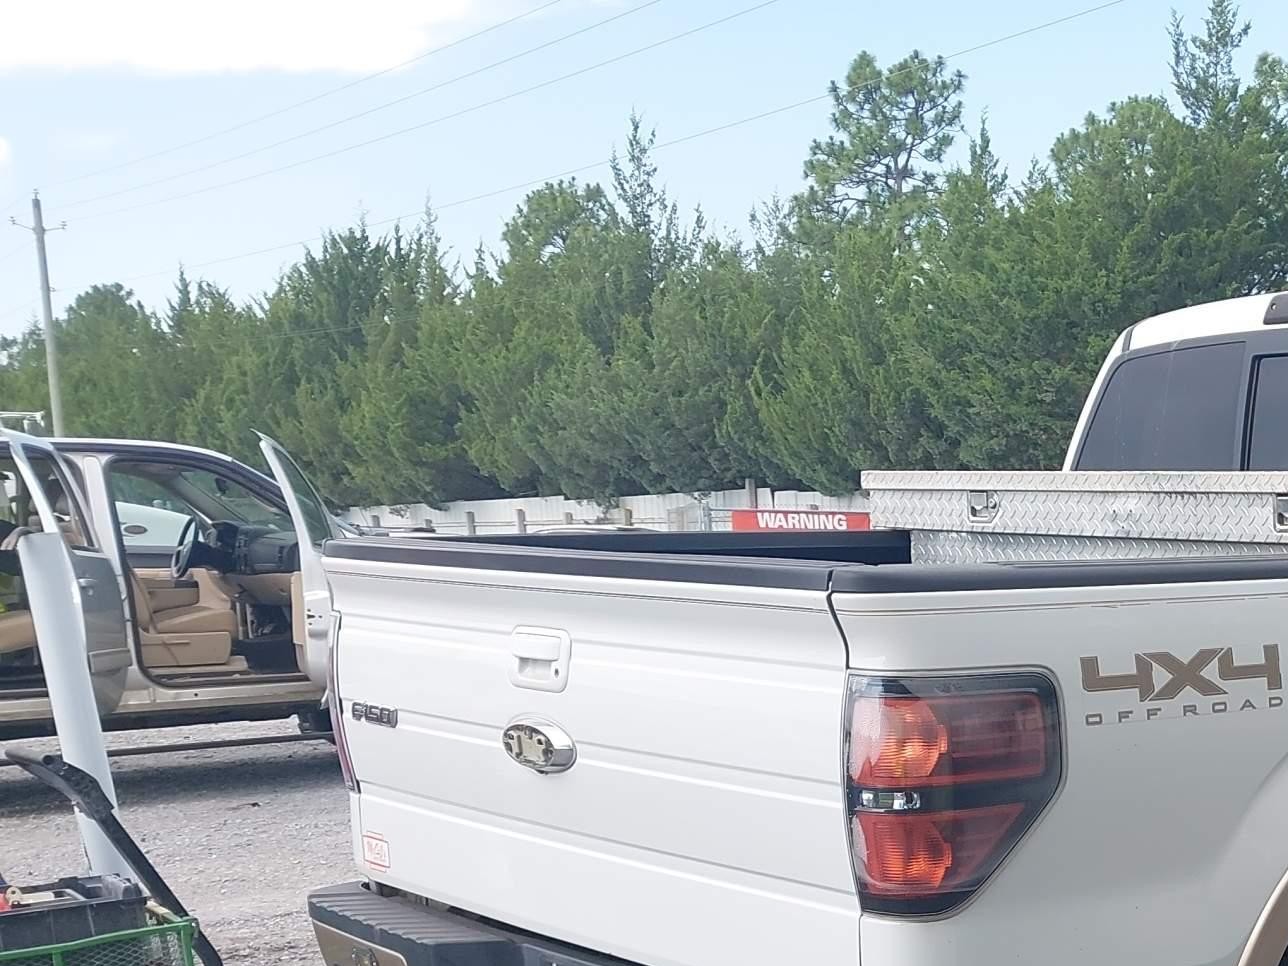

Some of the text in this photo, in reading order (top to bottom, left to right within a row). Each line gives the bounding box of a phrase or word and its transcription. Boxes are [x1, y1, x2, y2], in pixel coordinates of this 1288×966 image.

[757, 512, 847, 531] WARNING
[1080, 643, 1283, 703] 4X4
[1085, 696, 1284, 727] OFF ROAD
